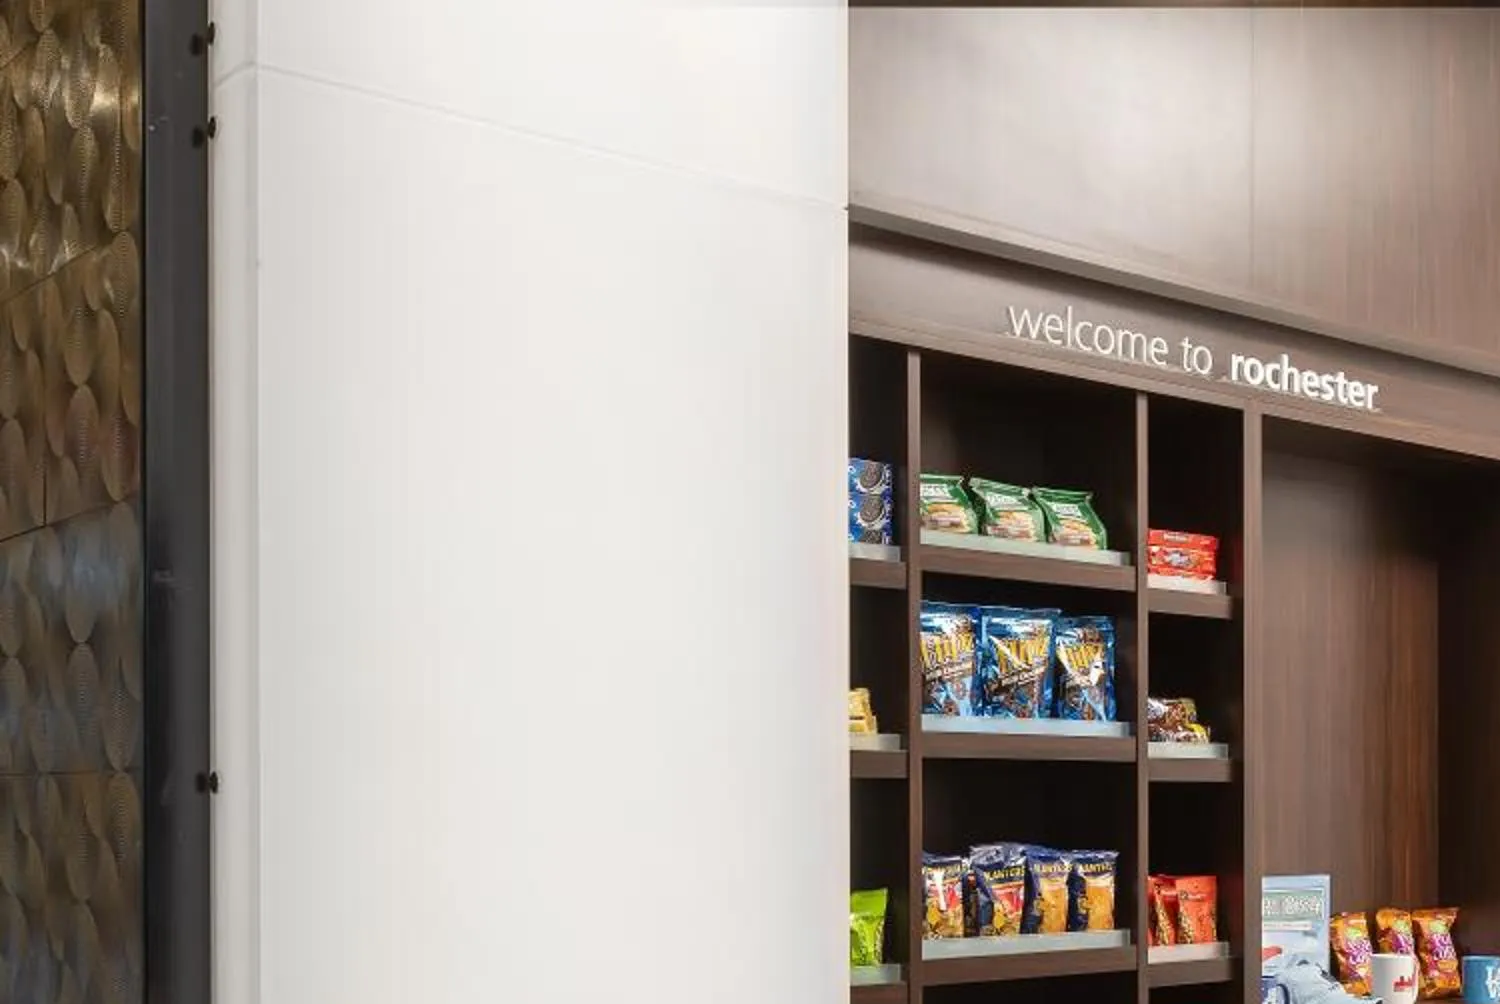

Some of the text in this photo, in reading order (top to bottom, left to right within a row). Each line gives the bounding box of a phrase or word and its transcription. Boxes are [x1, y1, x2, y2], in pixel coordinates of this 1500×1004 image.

[1008, 305, 1379, 409] welcome to rochester
